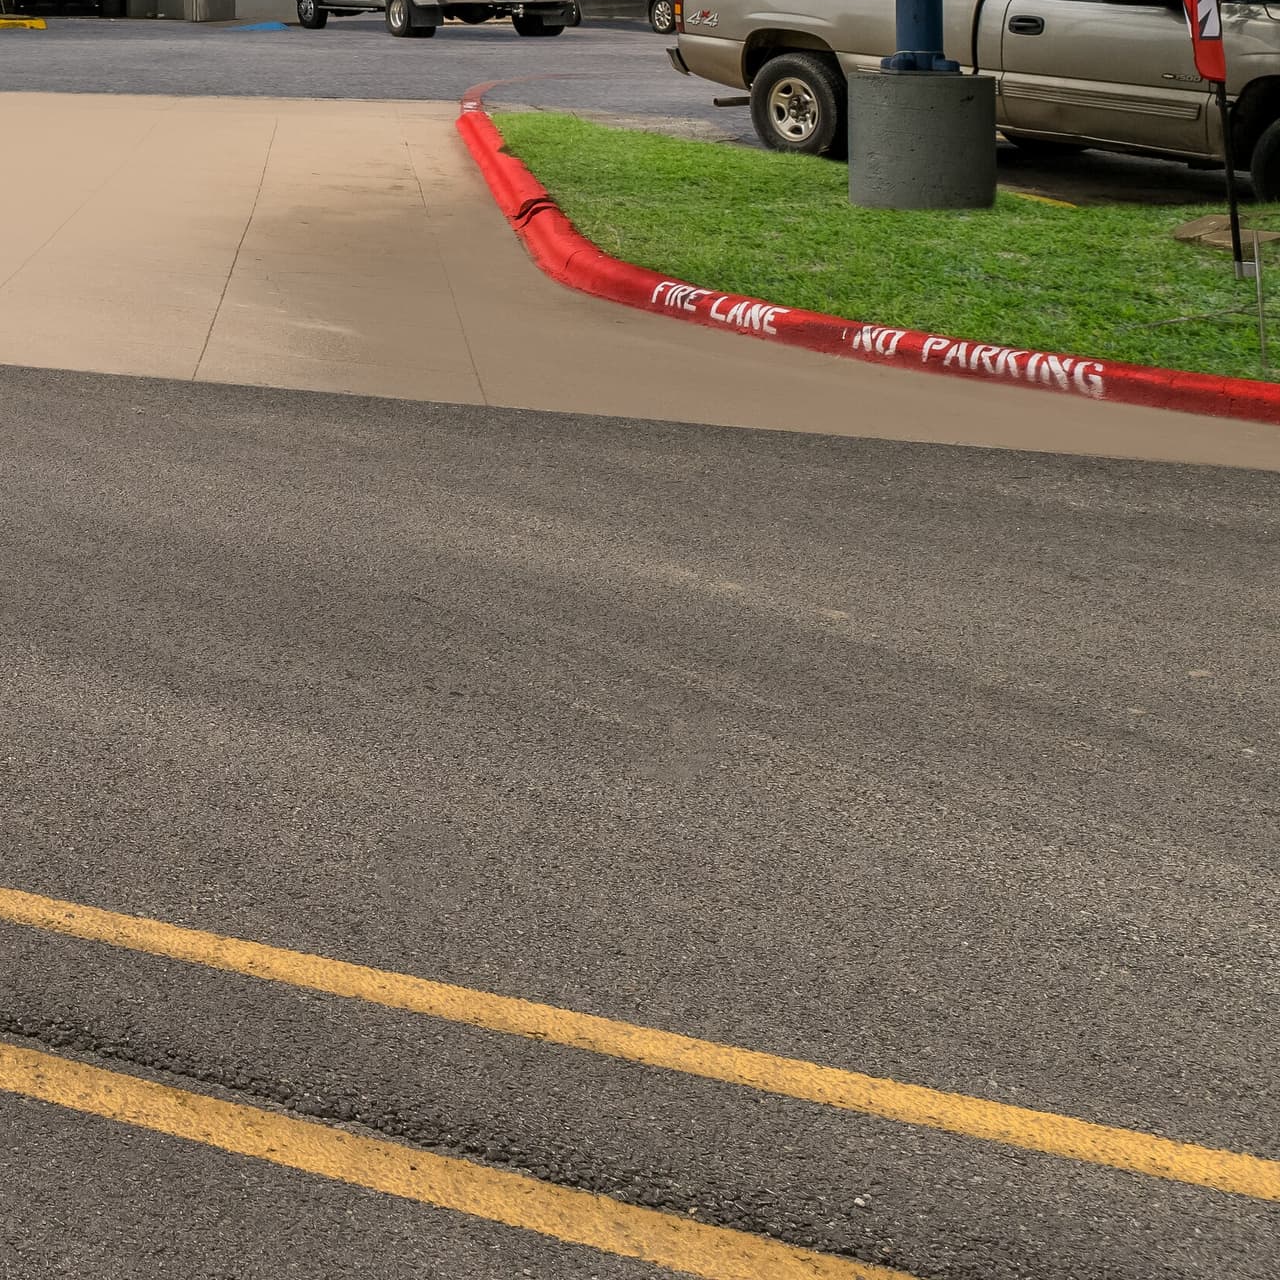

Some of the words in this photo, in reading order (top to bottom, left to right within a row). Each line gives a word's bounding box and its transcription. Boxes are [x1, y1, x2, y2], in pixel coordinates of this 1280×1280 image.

[651, 280, 708, 312] FIRE
[709, 295, 791, 336] LANE
[852, 325, 907, 356] NO
[921, 335, 1106, 400] PARKING
